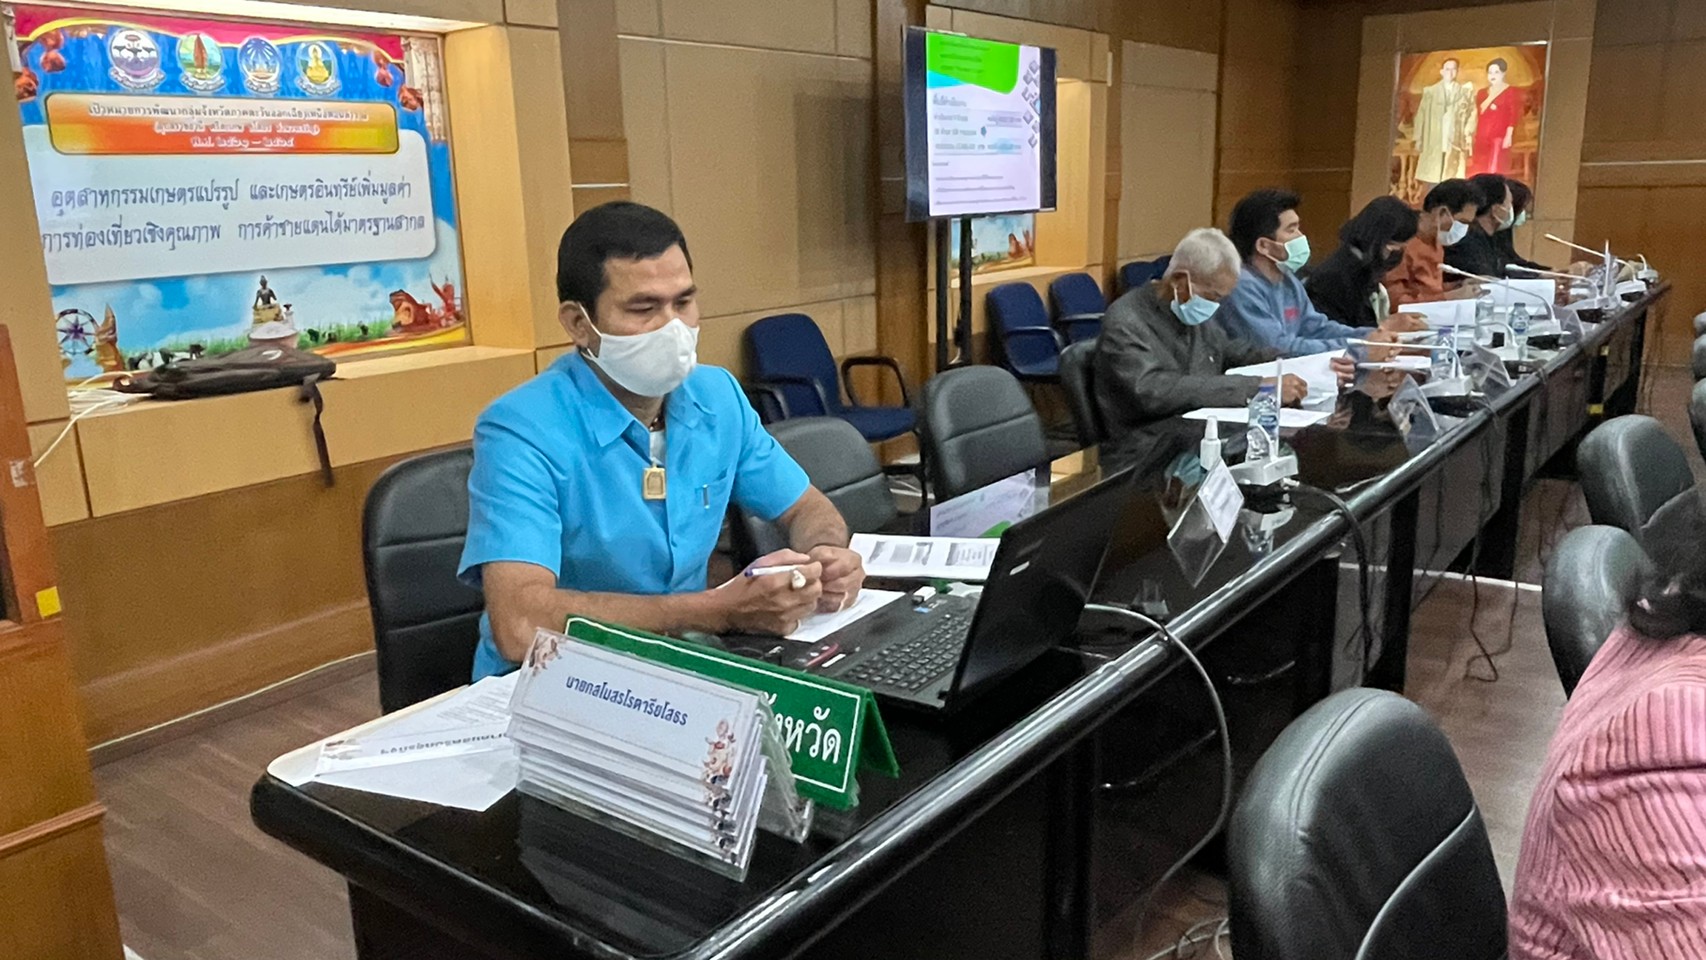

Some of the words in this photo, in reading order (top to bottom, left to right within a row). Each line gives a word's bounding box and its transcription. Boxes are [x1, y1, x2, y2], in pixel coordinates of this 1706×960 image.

[51, 178, 240, 217] อุตสาหกรรมเกษตรแปรรูป
[250, 170, 412, 205] และเกษตรอินทรีย์เพิ่มมูลค่า
[42, 214, 221, 253] การท่องเที่ยวเชิงคุณภาพ
[238, 210, 425, 240] การค้าชายแดนได้มาตรฐานสากล
[566, 676, 688, 726] นายกสโมสรโรตารียโสธร
[763, 691, 842, 765] ังหวัด
